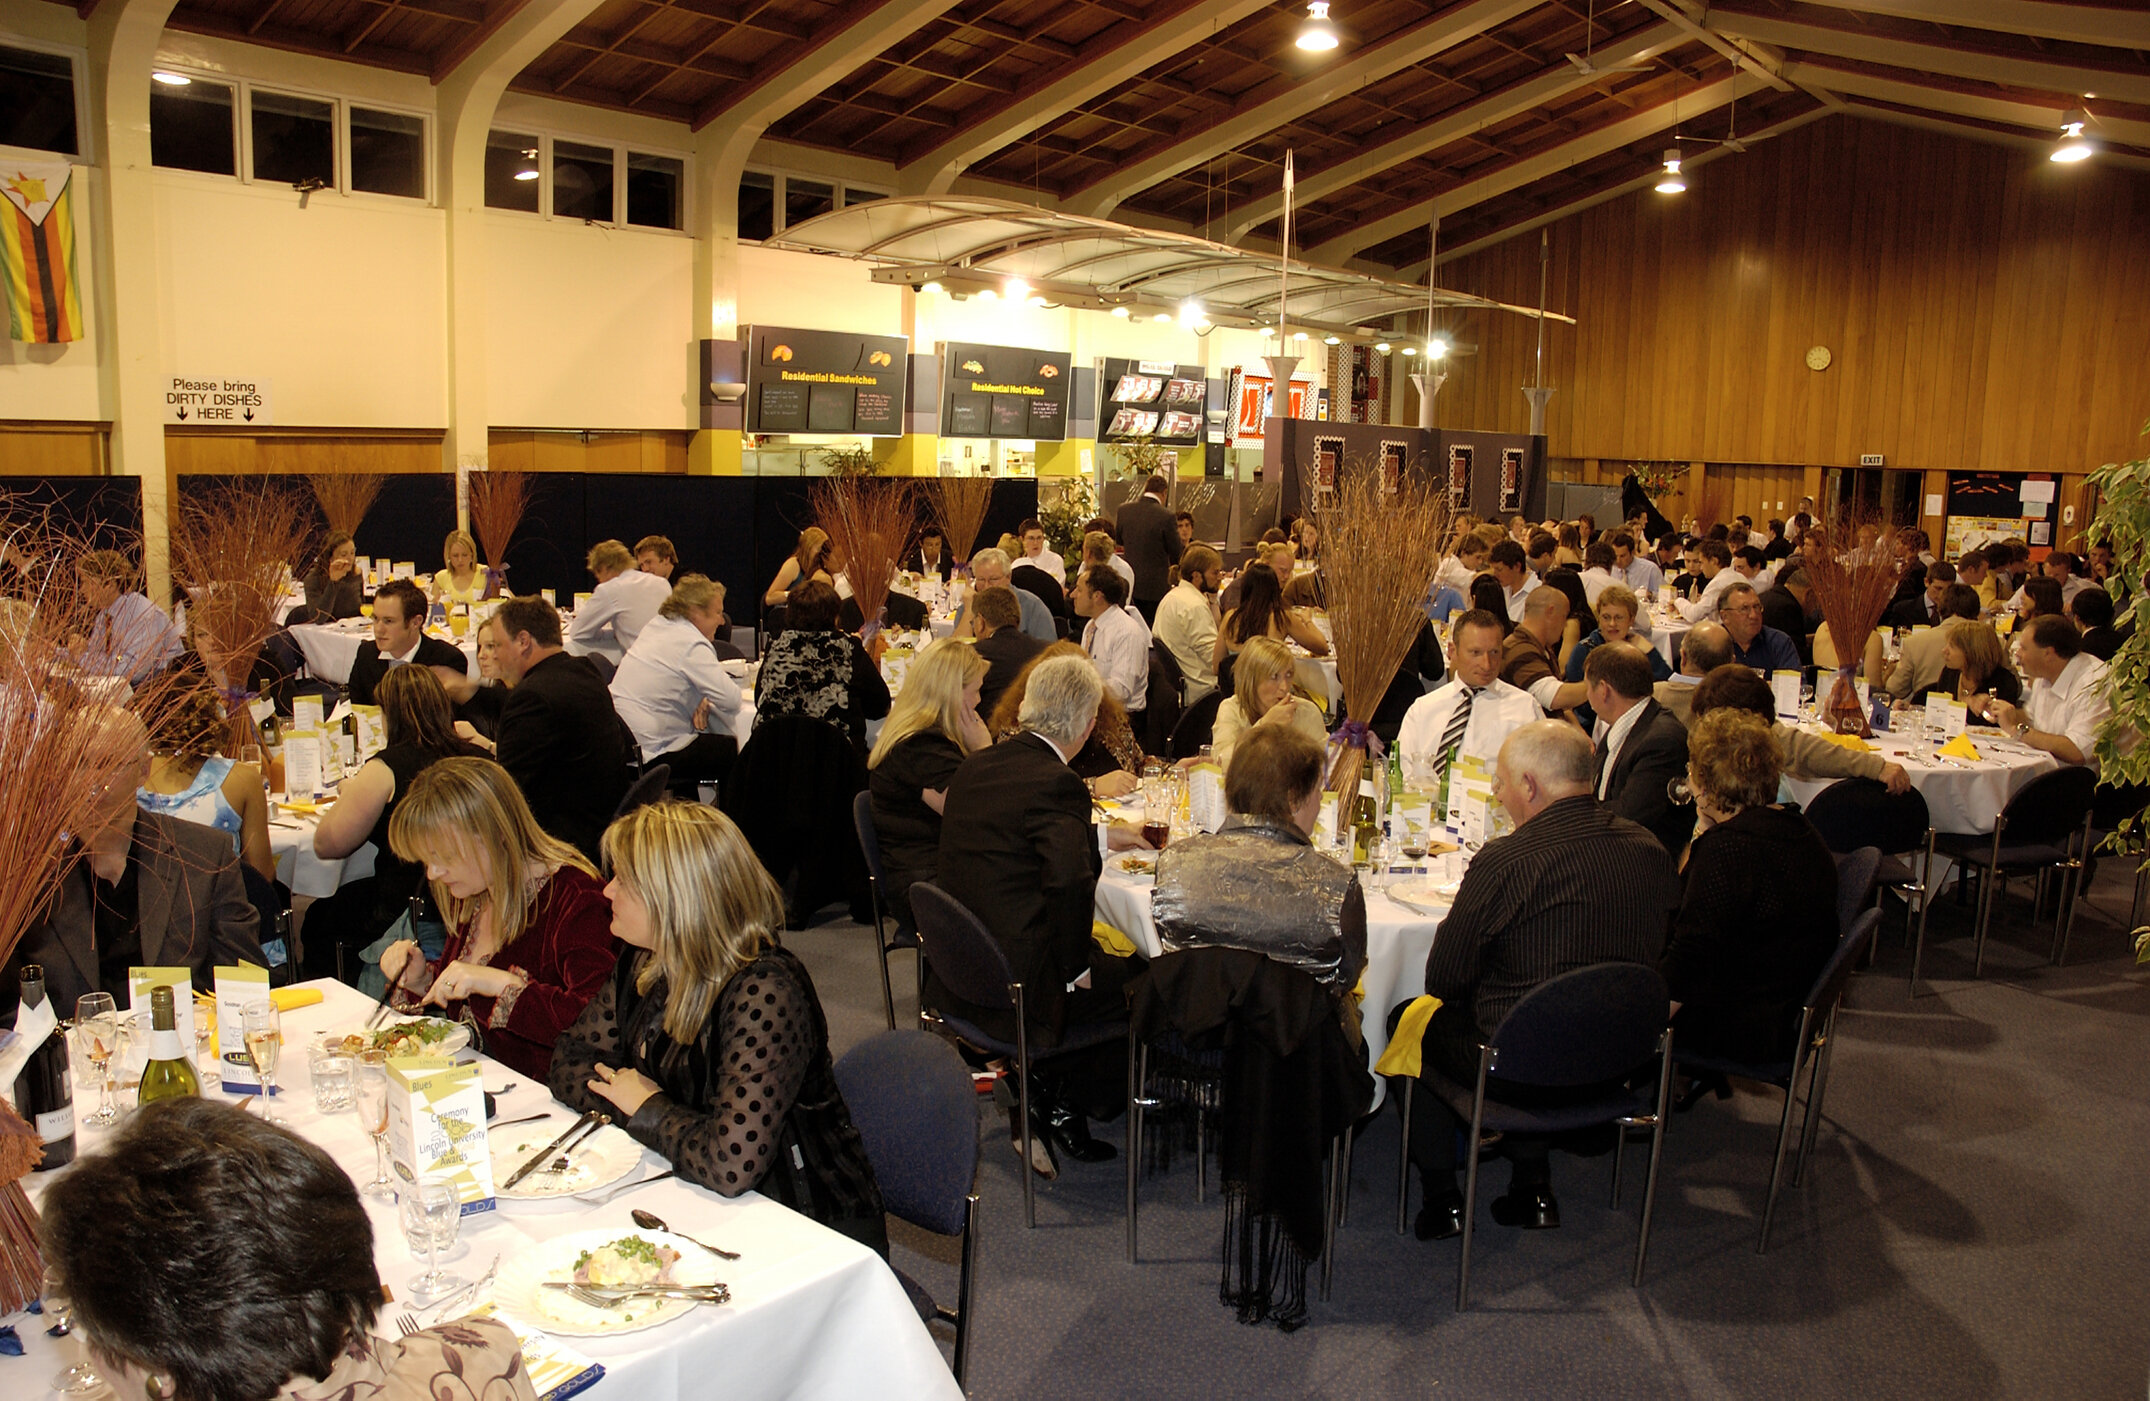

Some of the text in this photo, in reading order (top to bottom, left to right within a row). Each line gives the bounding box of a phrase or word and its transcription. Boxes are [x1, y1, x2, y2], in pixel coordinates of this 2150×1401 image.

[781, 370, 877, 386] Residential Sandwiches
[173, 378, 256, 395] Please bring
[971, 381, 1010, 394] Residential
[1022, 385, 1045, 396] Choice
[166, 393, 262, 407] DIRTY DISHES
[197, 408, 234, 420] HERE
[1863, 456, 1881, 464] EXIT
[1875, 713, 1884, 726] 6
[223, 1068, 253, 1076] LINCOL
[412, 1080, 433, 1093] Blues
[430, 1106, 469, 1123] Ceremony
[437, 1117, 464, 1130] for the
[419, 1138, 447, 1154] Lincoln
[448, 1130, 486, 1146] University
[431, 1148, 448, 1160] Blue
[440, 1151, 468, 1167] Awards
[460, 1199, 495, 1216] OLDS
[558, 1364, 599, 1394] GOLDS
